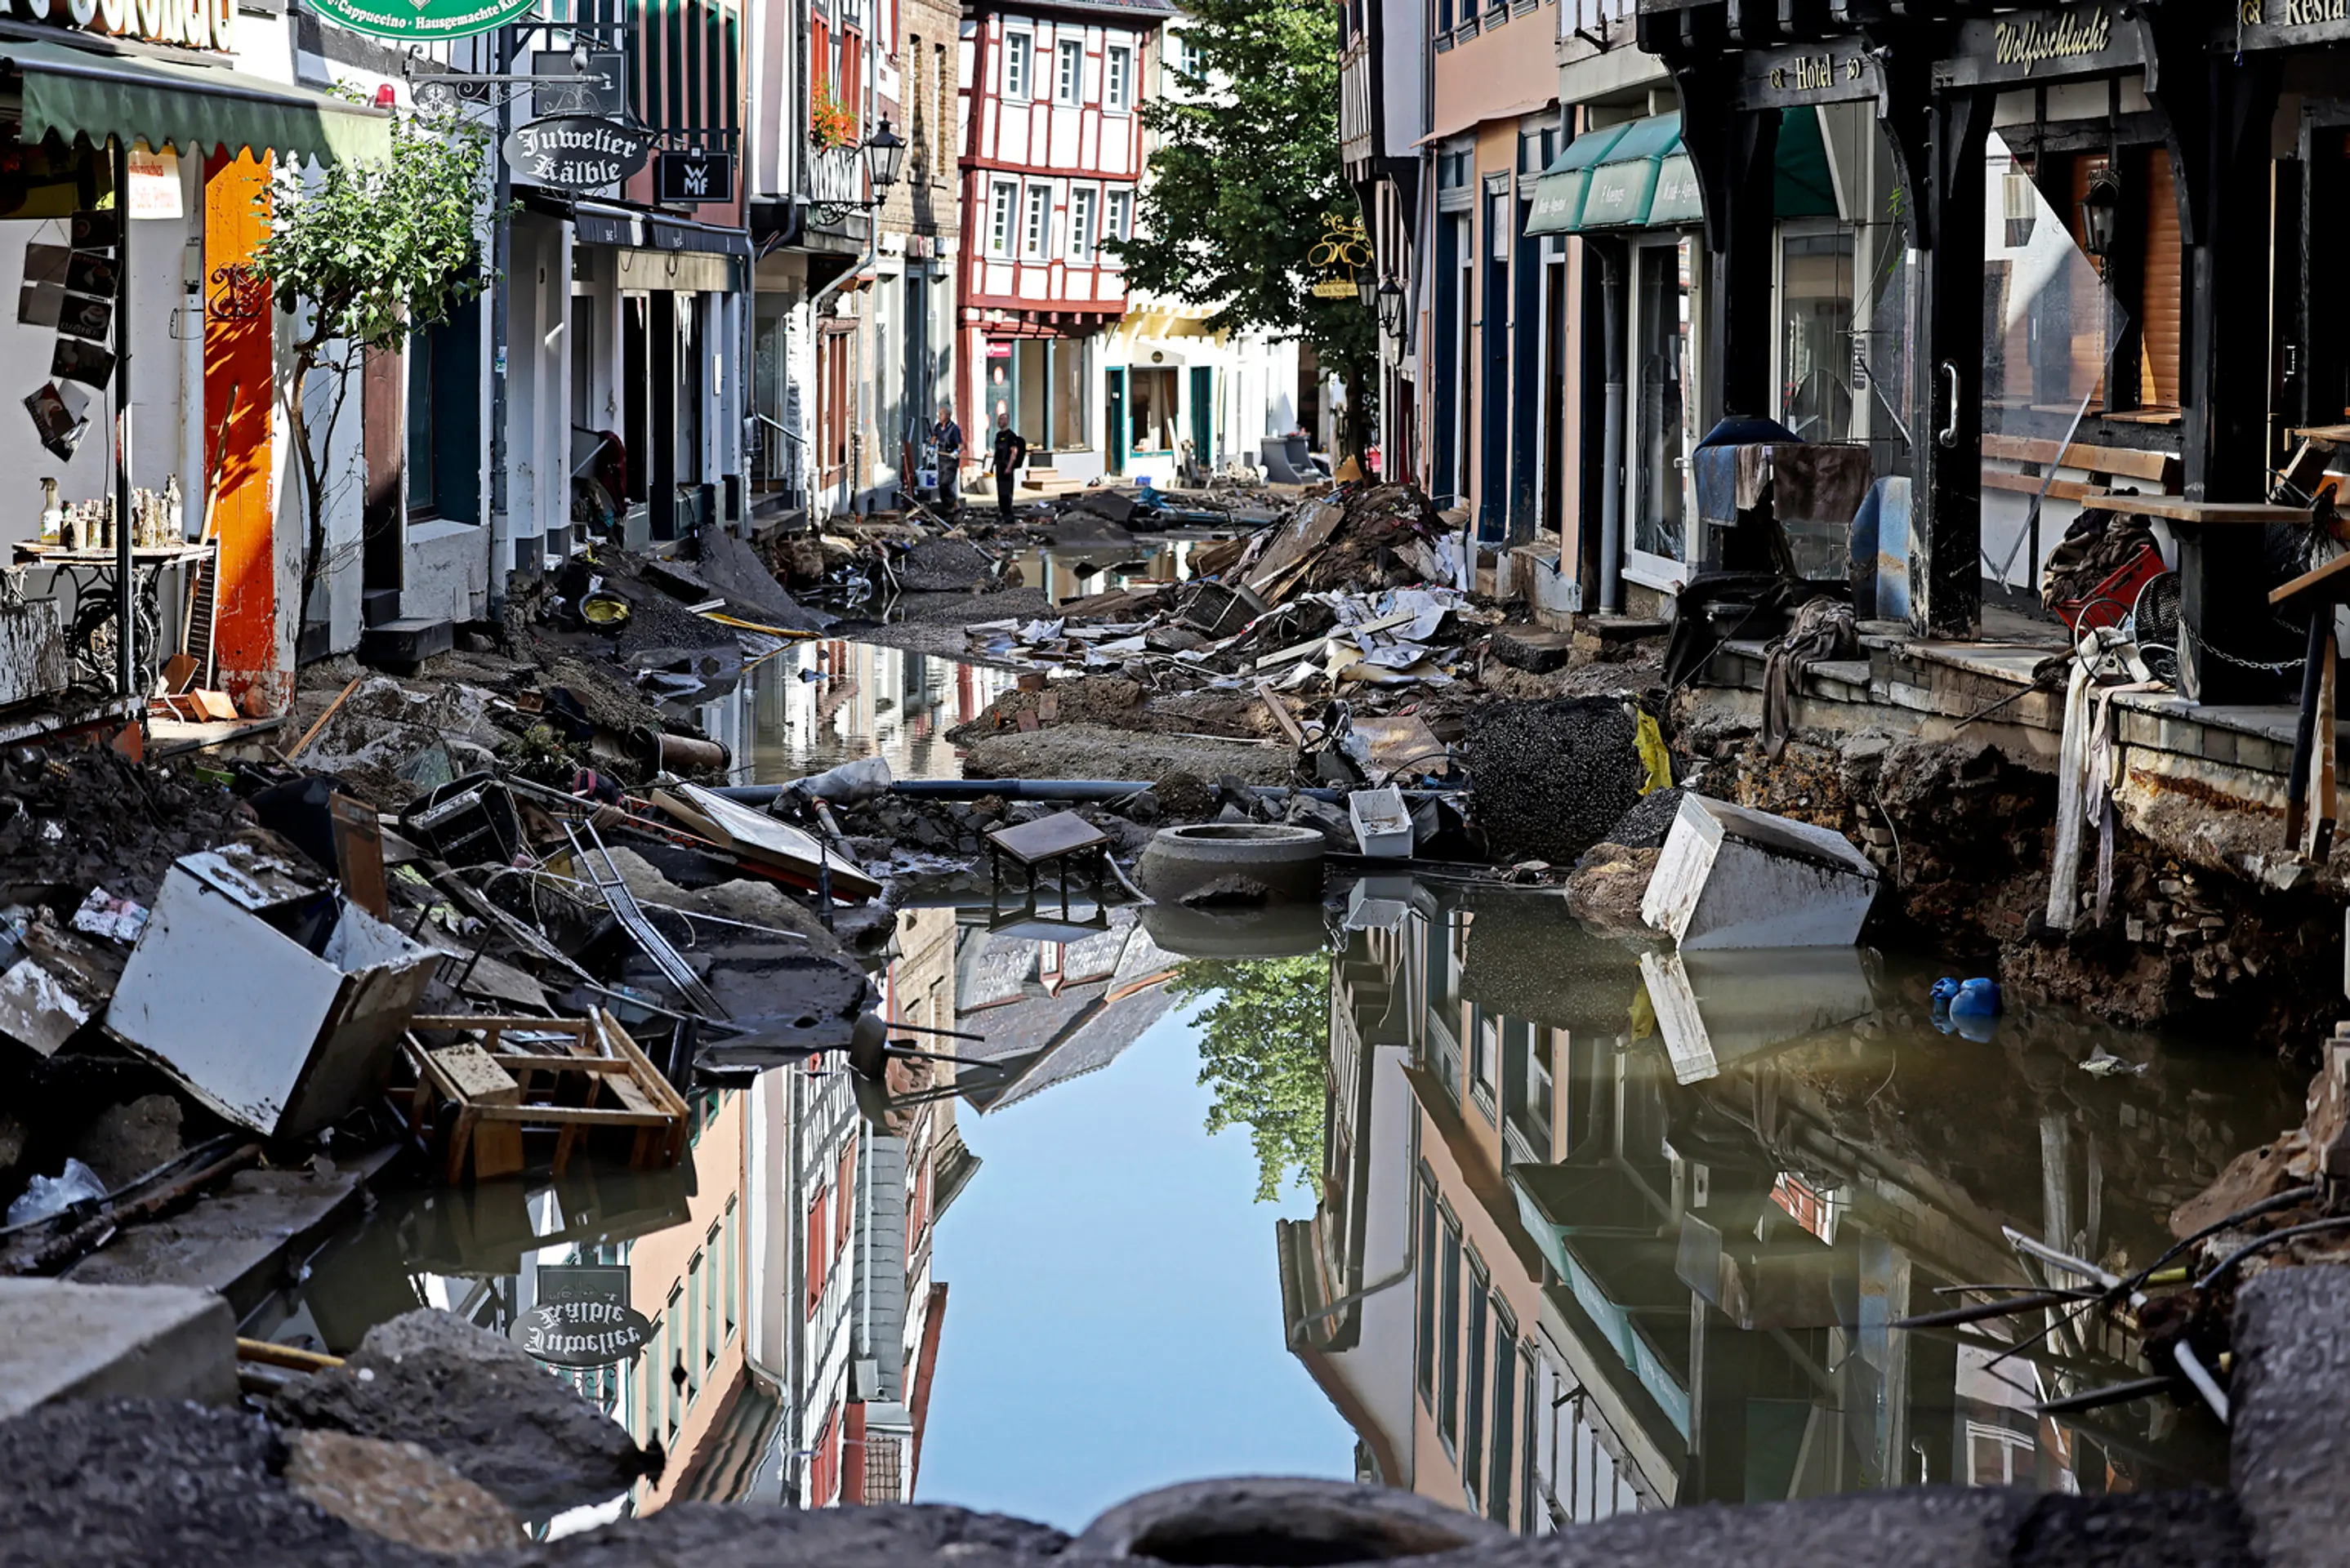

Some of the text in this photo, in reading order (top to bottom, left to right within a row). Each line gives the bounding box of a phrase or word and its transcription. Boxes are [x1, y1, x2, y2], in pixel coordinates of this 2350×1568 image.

[337, 0, 406, 29] Cappuccino
[415, 5, 500, 31] Hausgemachte
[2284, 0, 2350, 26] Resta
[1995, 7, 2110, 75] Wolfsschlucht
[1795, 54, 1835, 90] Hotel
[517, 127, 637, 158] Juwelier
[527, 154, 622, 185] Kälble
